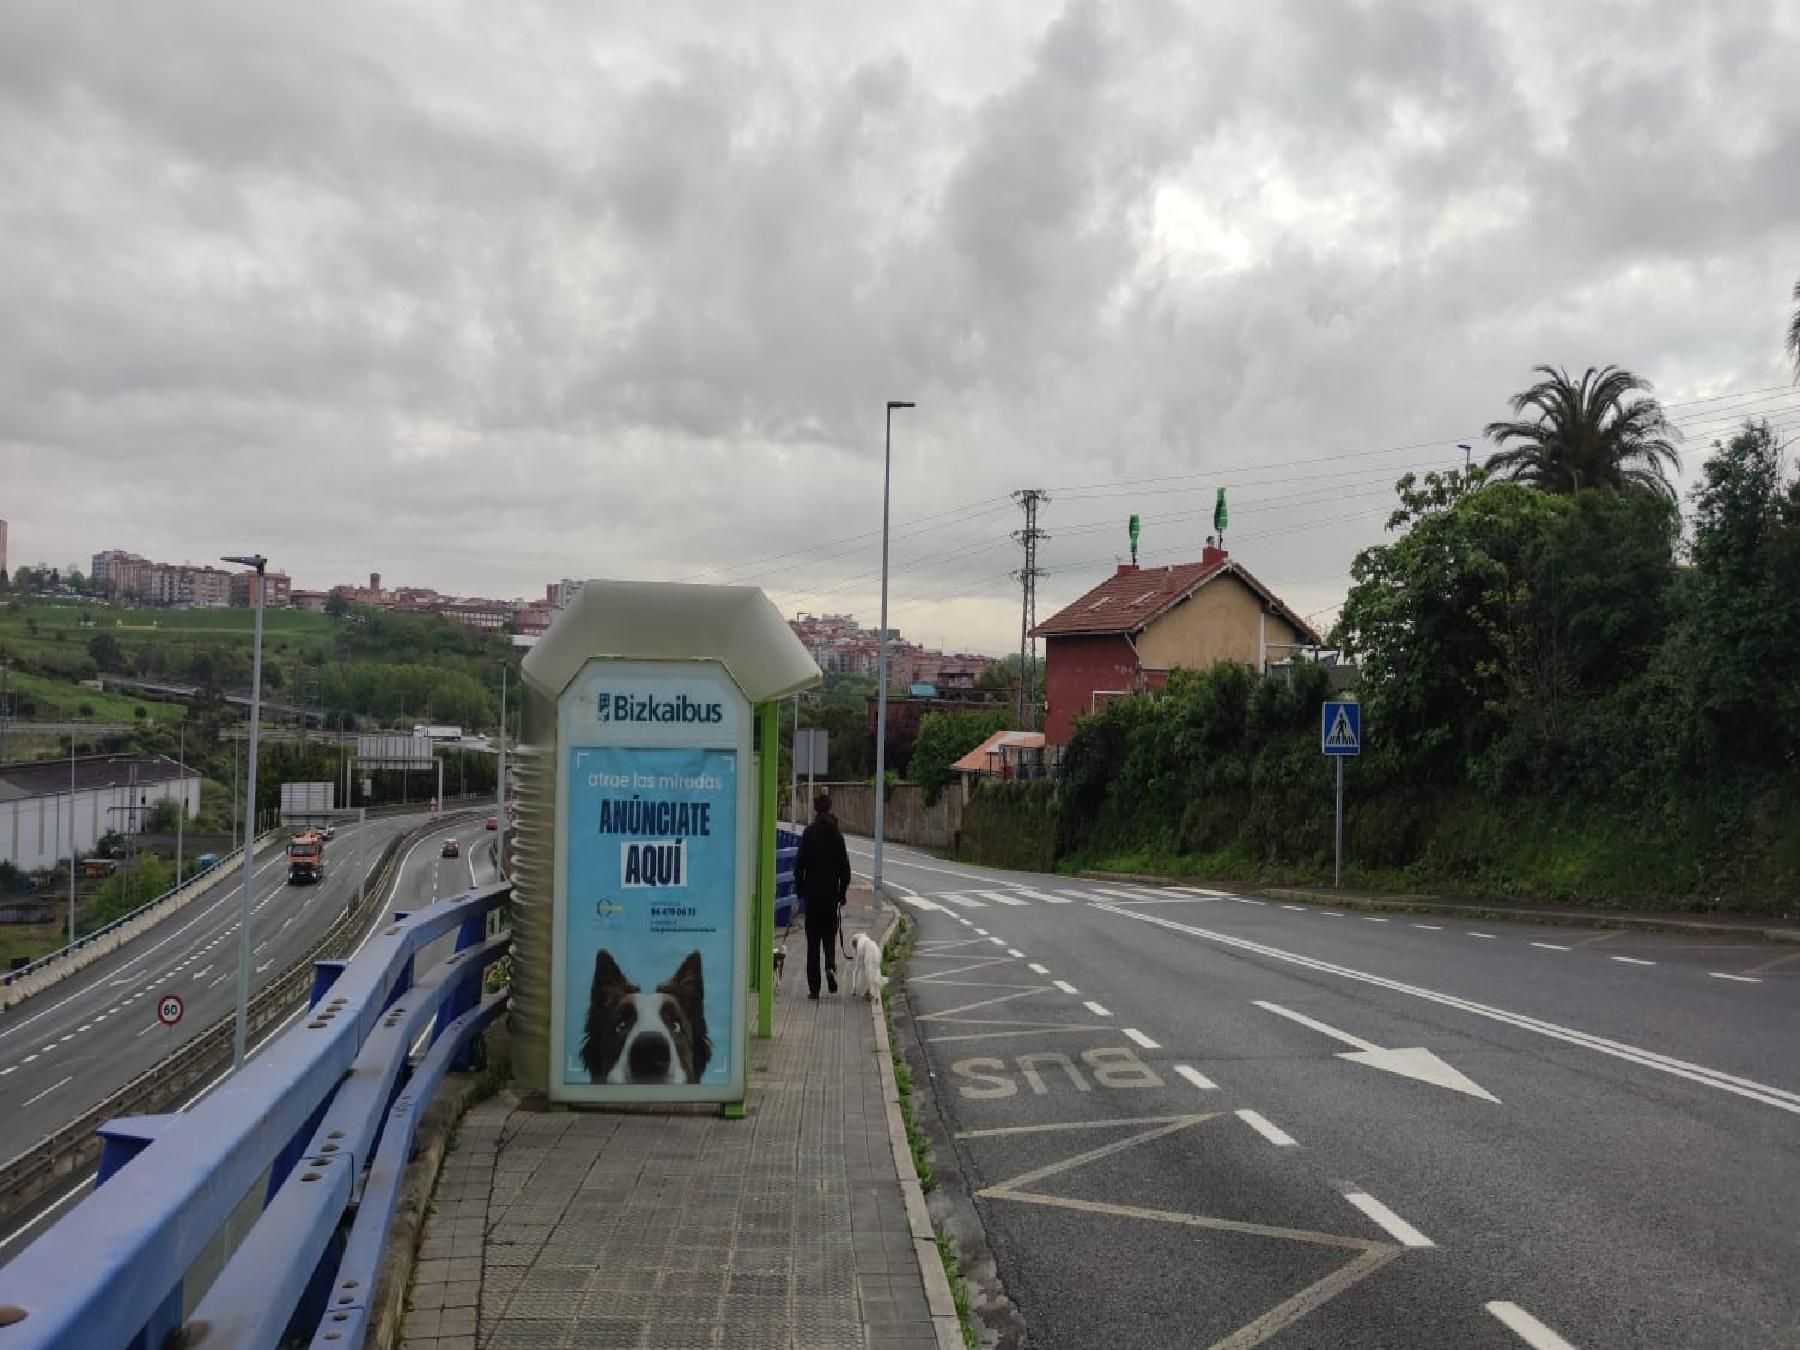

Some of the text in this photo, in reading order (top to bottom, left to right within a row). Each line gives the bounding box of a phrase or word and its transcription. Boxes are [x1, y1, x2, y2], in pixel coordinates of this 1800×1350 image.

[614, 693, 722, 723] Bizkaibus
[588, 770, 723, 790] atrae las miradas
[599, 794, 710, 836] ANÚNCIATE
[625, 838, 682, 886] AQUÍ
[164, 1005, 177, 1015] 60
[952, 1047, 1167, 1099] BUS
